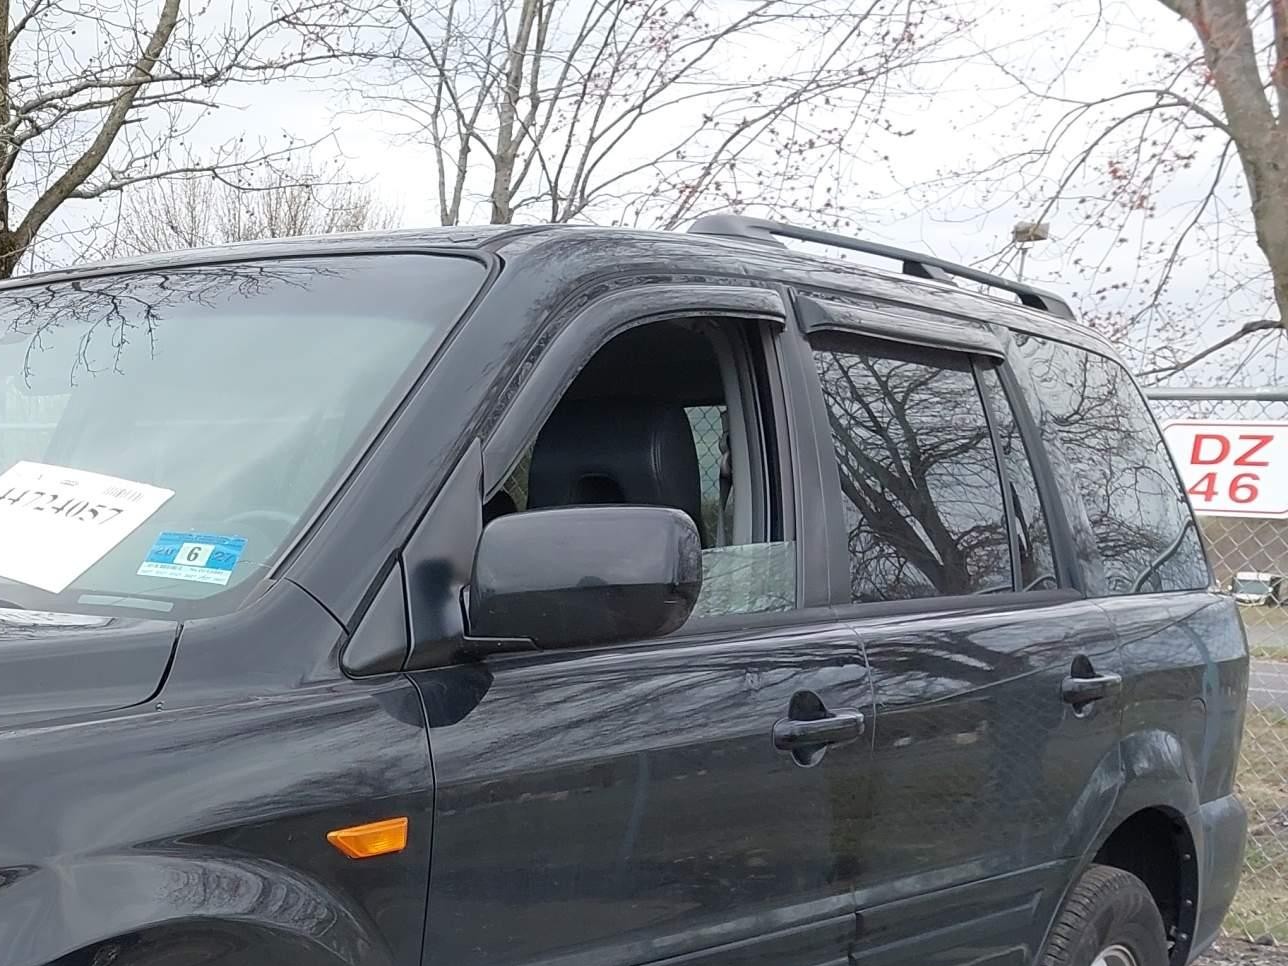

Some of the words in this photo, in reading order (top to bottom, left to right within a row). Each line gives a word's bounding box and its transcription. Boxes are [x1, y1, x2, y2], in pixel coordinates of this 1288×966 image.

[1190, 433, 1274, 467] DZ
[1187, 472, 1261, 504] 46
[186, 546, 202, 562] 6
